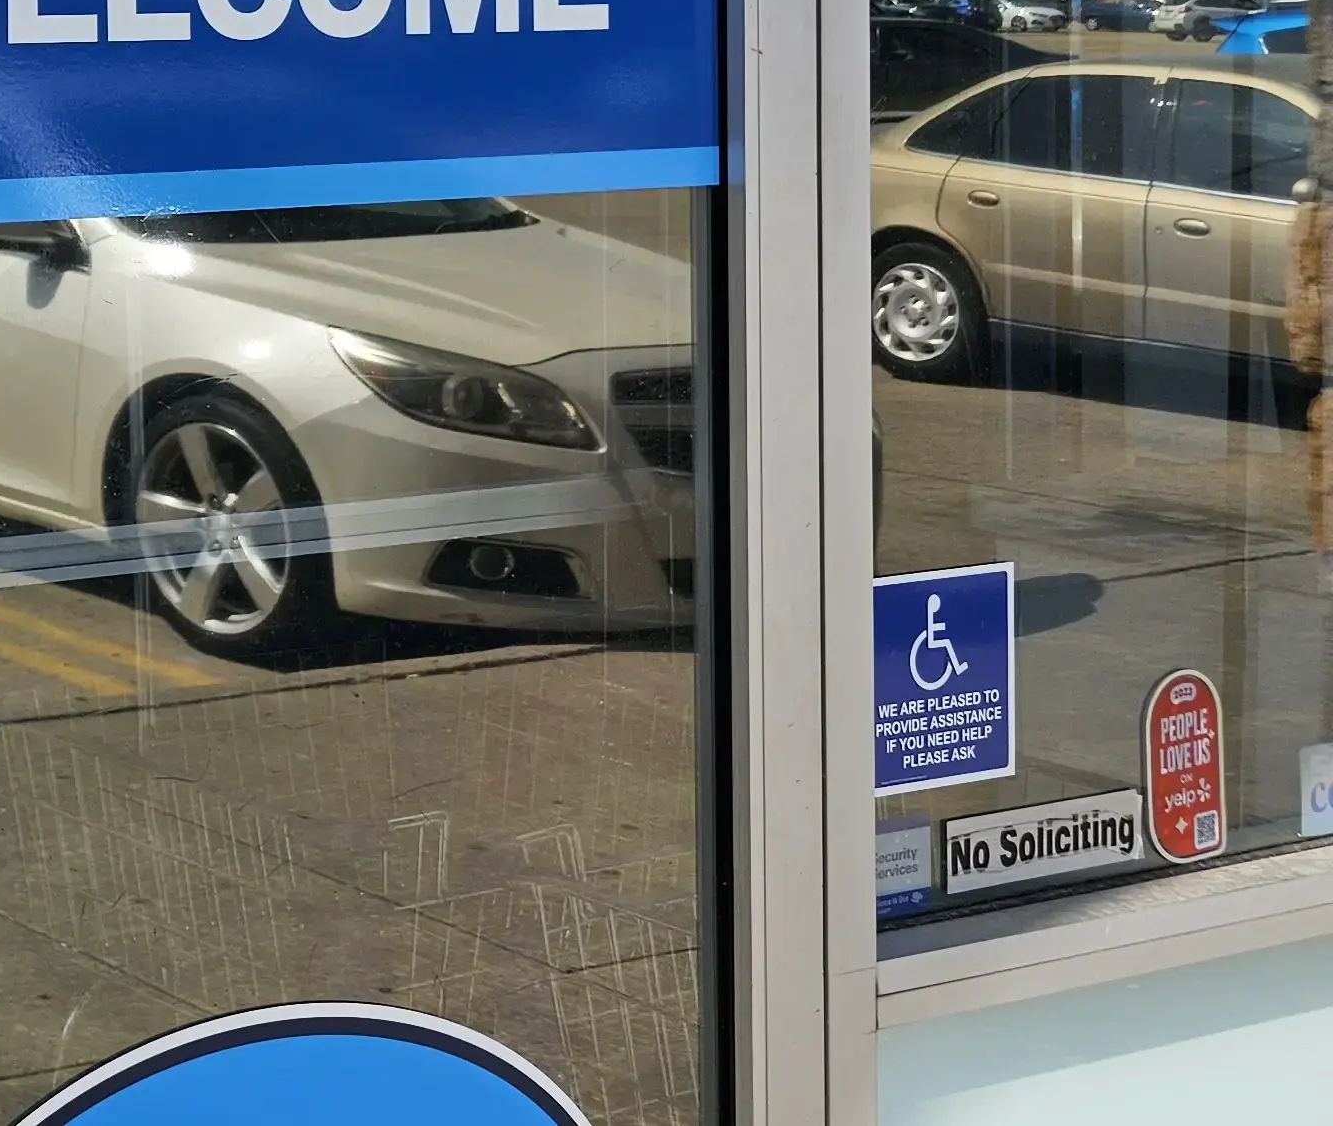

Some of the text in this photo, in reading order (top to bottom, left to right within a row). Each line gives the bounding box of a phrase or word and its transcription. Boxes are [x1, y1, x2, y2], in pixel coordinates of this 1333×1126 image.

[878, 689, 1000, 718] WE ARE PLEASED TO
[876, 706, 1002, 737] PROVIDE ASSISTANCE
[1161, 708, 1209, 744] PEOPLE
[886, 725, 992, 753] IF YOU NEED HELP
[903, 745, 976, 769] PLEASE ASK
[1159, 738, 1211, 774] LOVE US
[1180, 773, 1193, 783] ON
[1164, 786, 1197, 813] yelp
[875, 847, 918, 864] ecurity
[950, 809, 1134, 877] No Soliciting
[875, 863, 919, 880] ervices
